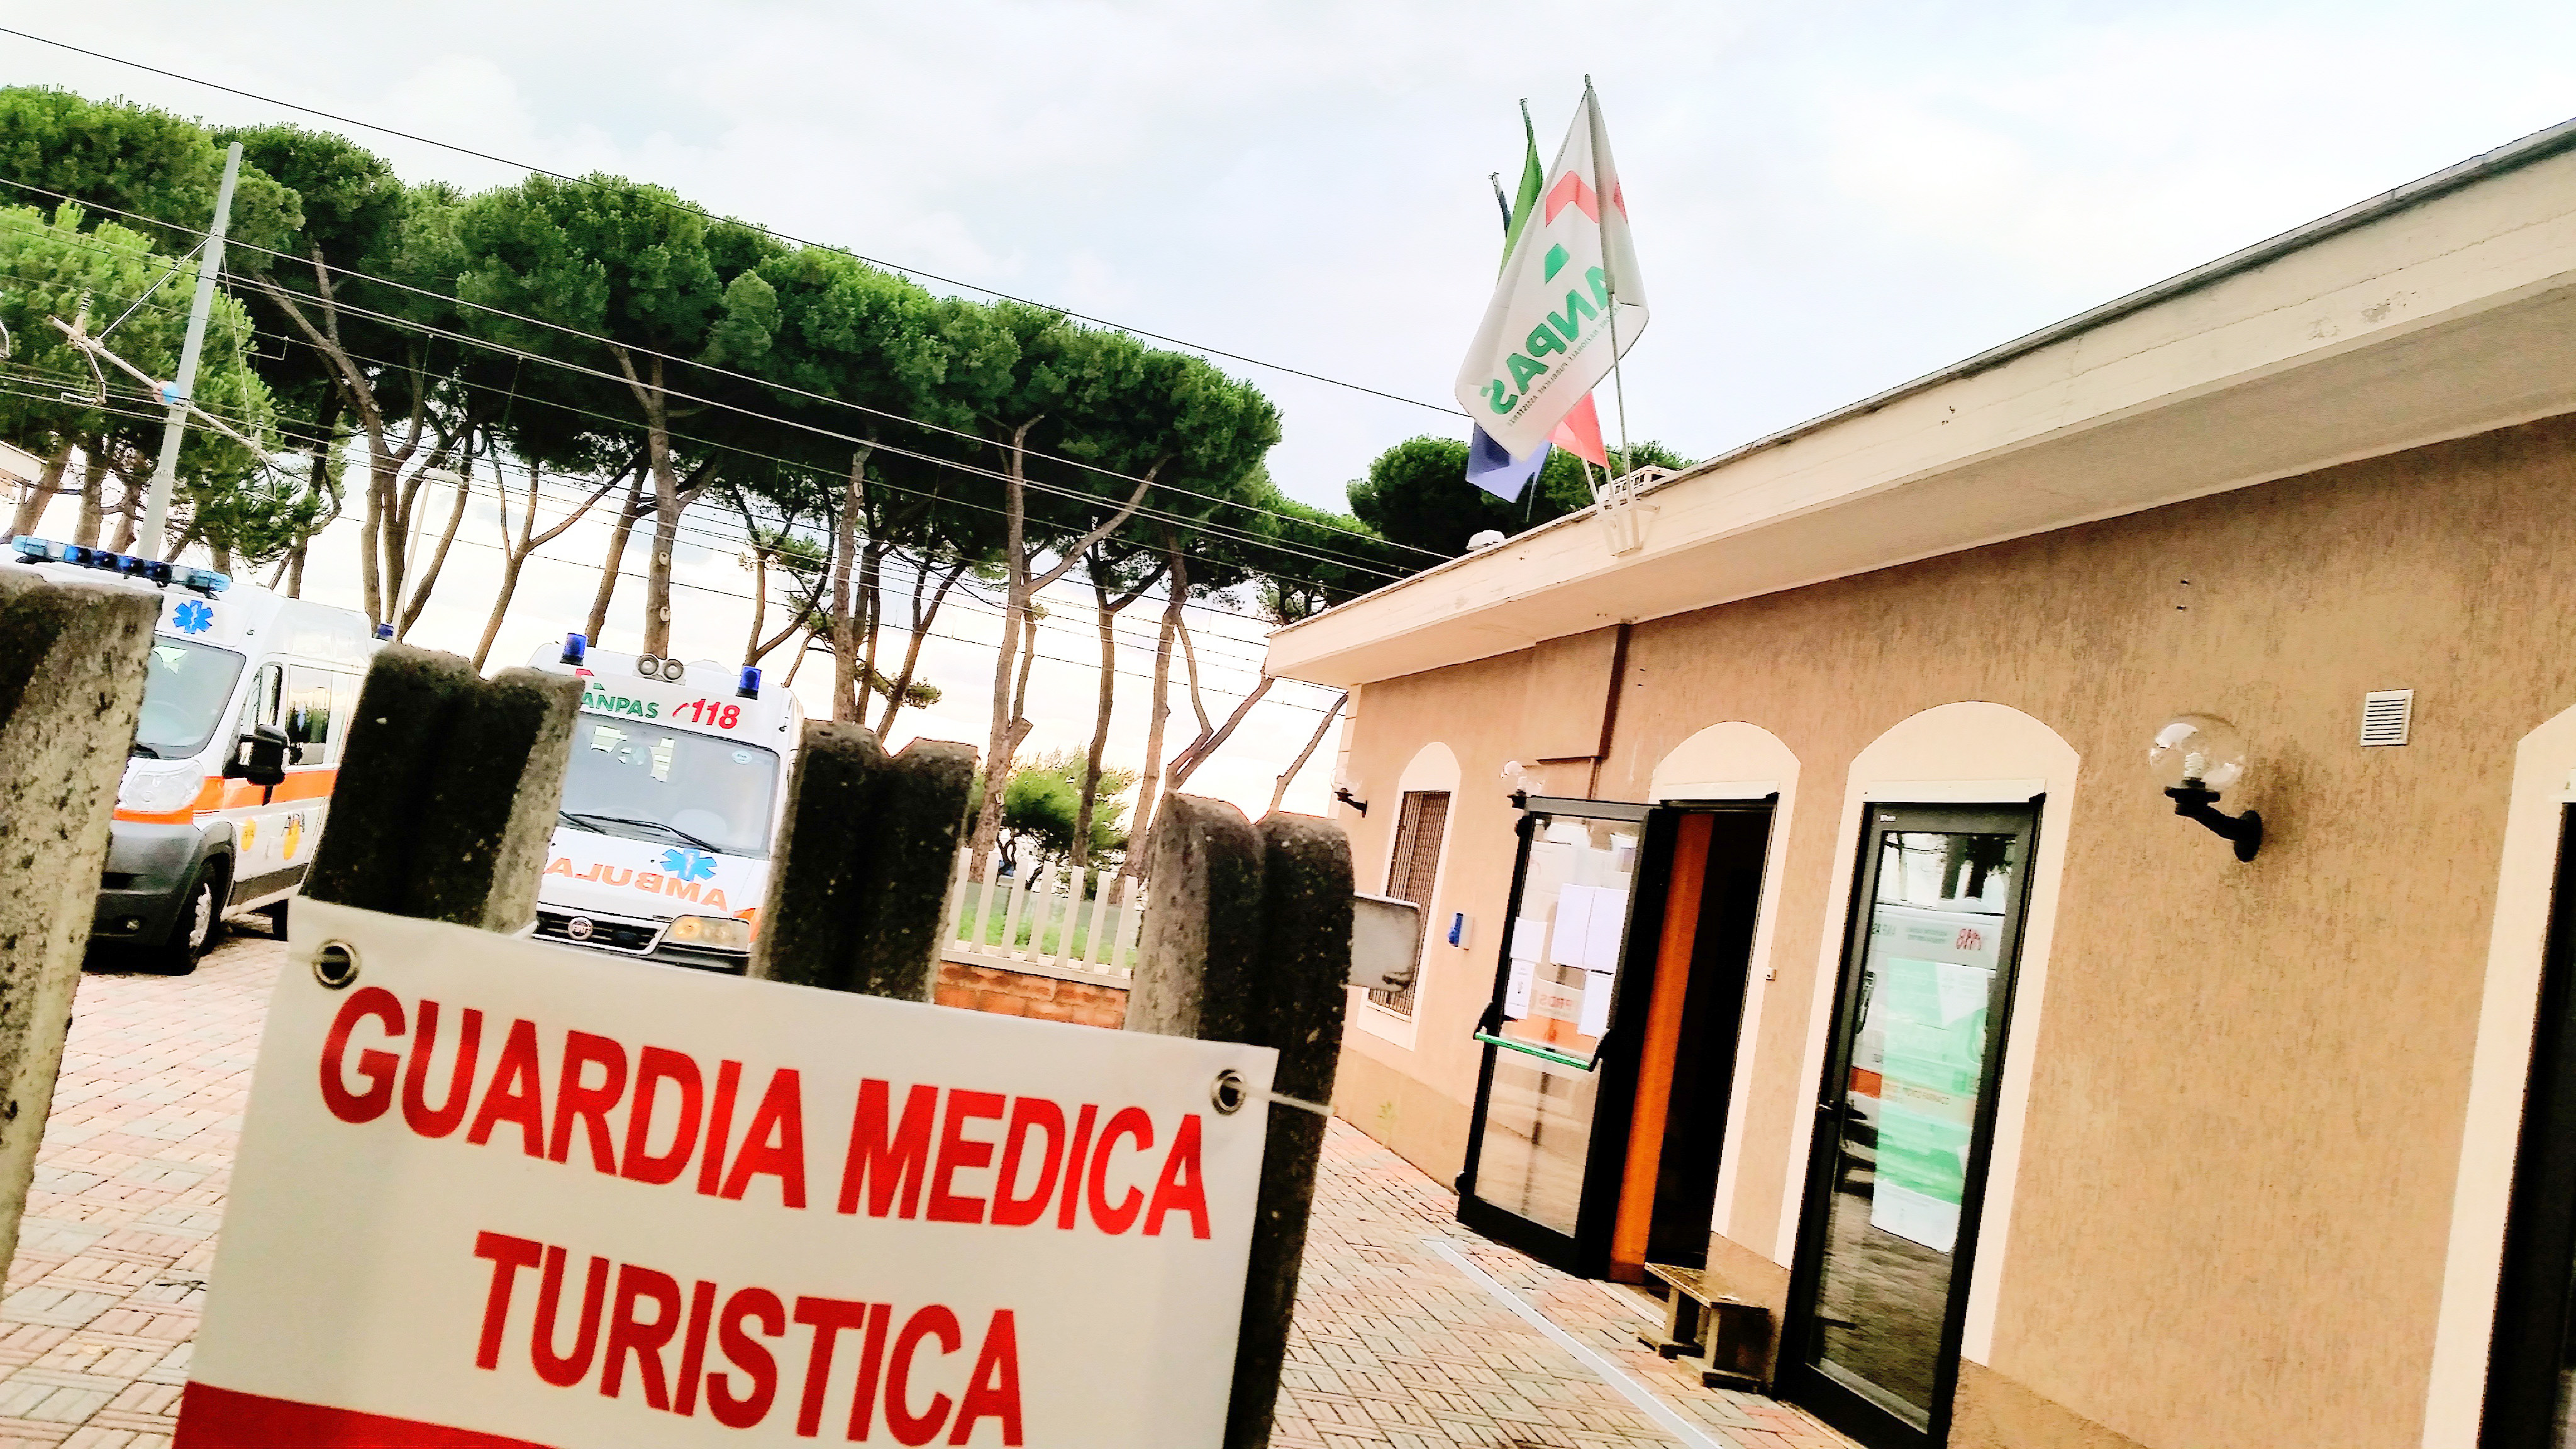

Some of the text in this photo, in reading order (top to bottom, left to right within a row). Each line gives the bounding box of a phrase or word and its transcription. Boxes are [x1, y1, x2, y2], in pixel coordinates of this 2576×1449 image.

[580, 692, 741, 730] ANPAS 118
[319, 986, 1211, 1240] GUARDIA MEDICA
[474, 1230, 1024, 1448] TURISTICA
